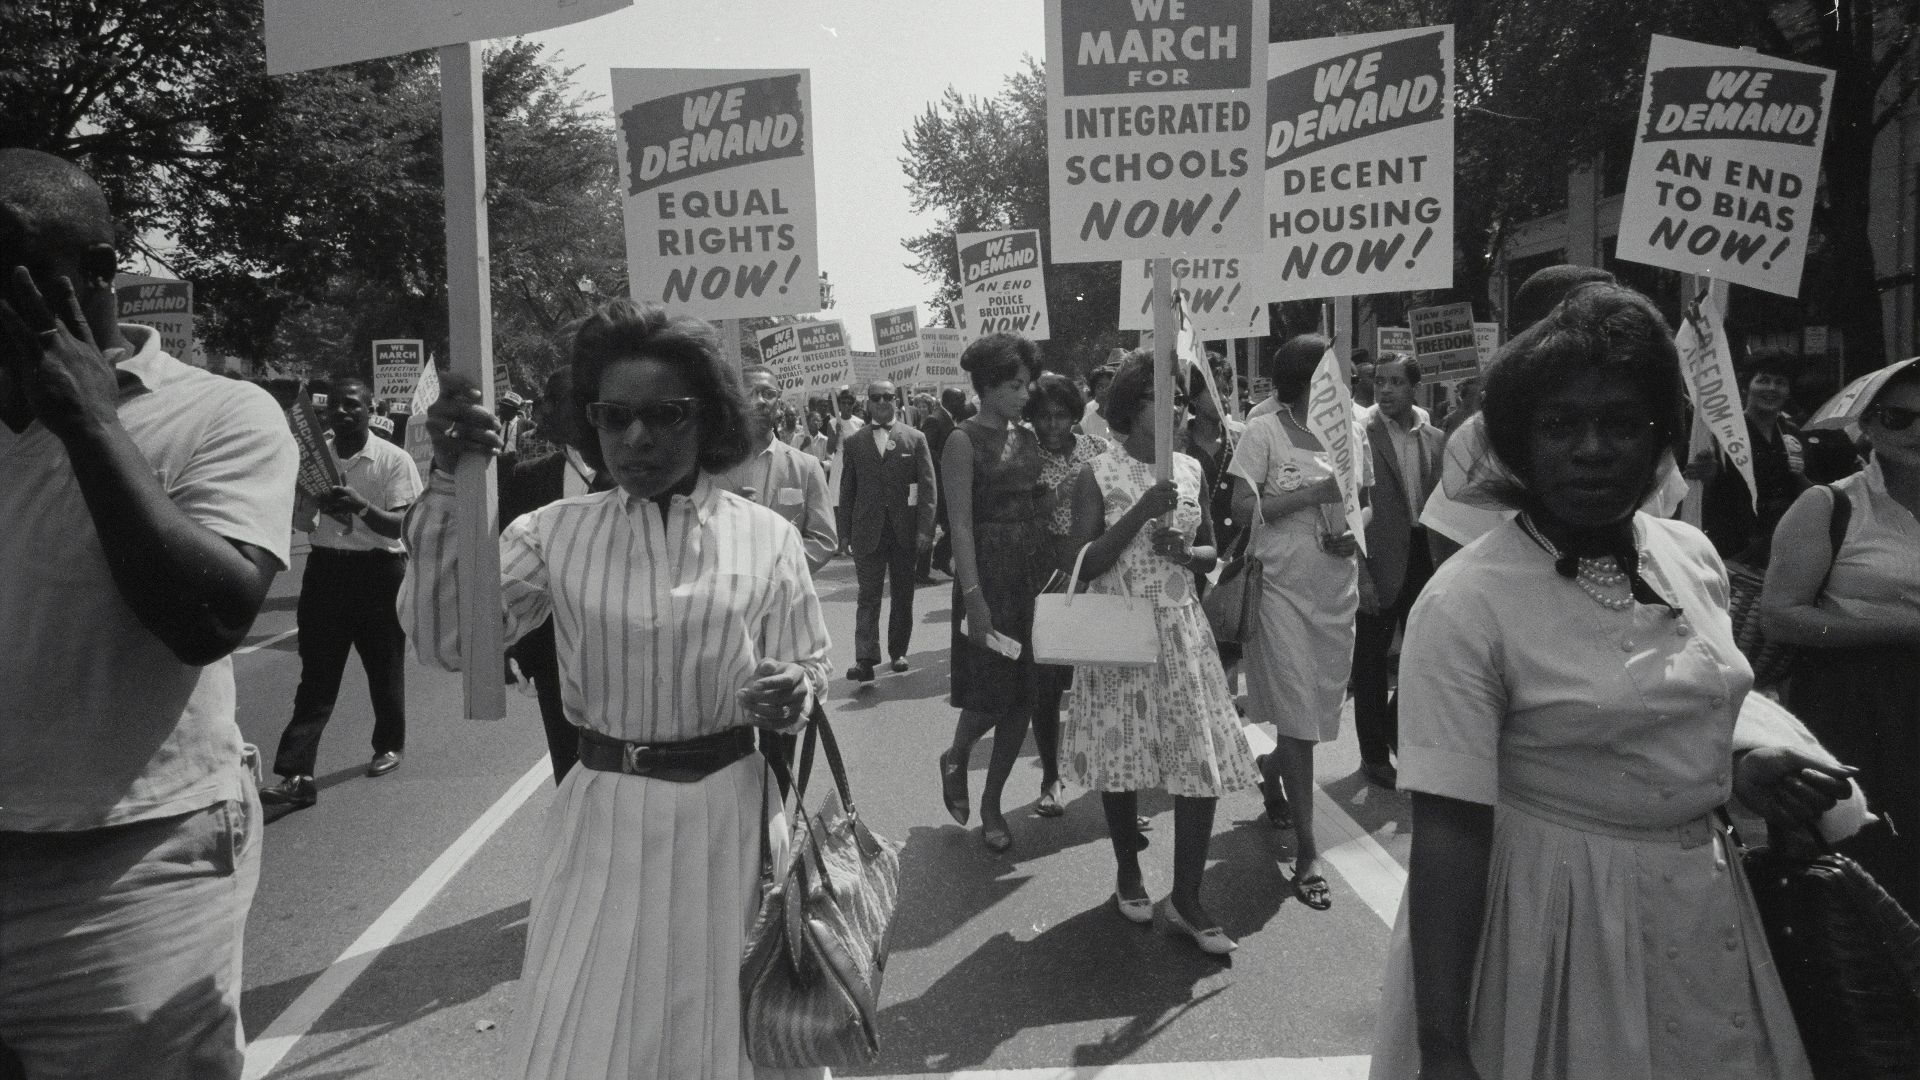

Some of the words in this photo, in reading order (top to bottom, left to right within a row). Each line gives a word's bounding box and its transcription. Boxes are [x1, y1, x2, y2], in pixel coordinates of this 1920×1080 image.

[1130, 0, 1185, 21] WE
[1077, 25, 1237, 65] MARCH
[1128, 69, 1189, 86] FOR
[1313, 52, 1382, 102] WE
[1706, 70, 1773, 99] WE
[683, 88, 745, 130] WE
[1266, 75, 1438, 158] DEMAND
[1655, 103, 1815, 134] DEMAND
[1065, 101, 1250, 139] INTEGRATED
[640, 114, 798, 181] DEMAND
[1066, 148, 1248, 185] SCHOOLS
[1284, 155, 1427, 196] DECENT
[1655, 149, 1712, 180] AN
[1725, 160, 1802, 199] END
[658, 189, 788, 219] EQUAL
[1080, 187, 1241, 241] NOW!
[1656, 181, 1702, 211] TO
[1712, 192, 1795, 232] BIAS
[1270, 197, 1441, 238] HOUSING
[658, 224, 795, 256] RIGHTS
[986, 237, 1013, 257] WE
[1649, 216, 1790, 270] NOW!
[969, 248, 1034, 280] DEMAND
[1282, 226, 1433, 281] NOW!
[663, 255, 801, 303] NOW!
[1144, 258, 1239, 279] RGHTS
[140, 285, 166, 298] WE
[975, 281, 997, 293] AN
[1002, 280, 1031, 291] END
[122, 297, 186, 315] DEMAND
[979, 305, 1031, 317] BRUTALITY
[989, 295, 1023, 306] POLICE
[980, 311, 1040, 335] NOW!
[1416, 311, 1439, 321] UAW
[774, 329, 792, 344] WE
[802, 332, 840, 346] MARCH
[812, 326, 827, 335] WE
[880, 321, 913, 338] MARCH
[921, 333, 936, 341] CIVIL
[1415, 320, 1452, 337] JOBS
[766, 339, 796, 359] DEMA
[880, 347, 898, 358] FIRST
[900, 341, 919, 353] CLASS
[1416, 334, 1474, 355] FREEDOM
[379, 351, 416, 360] MARCH
[771, 358, 784, 366] AN
[802, 349, 847, 363] INTEGRATED
[804, 359, 848, 373] SCHOOLS
[880, 351, 921, 368] CITIZENSHIP
[780, 364, 801, 373] POLICE
[811, 368, 848, 387] NOW!
[888, 363, 920, 382] NOW!
[291, 402, 315, 444] MARCH
[1309, 371, 1351, 477] FREEDOM
